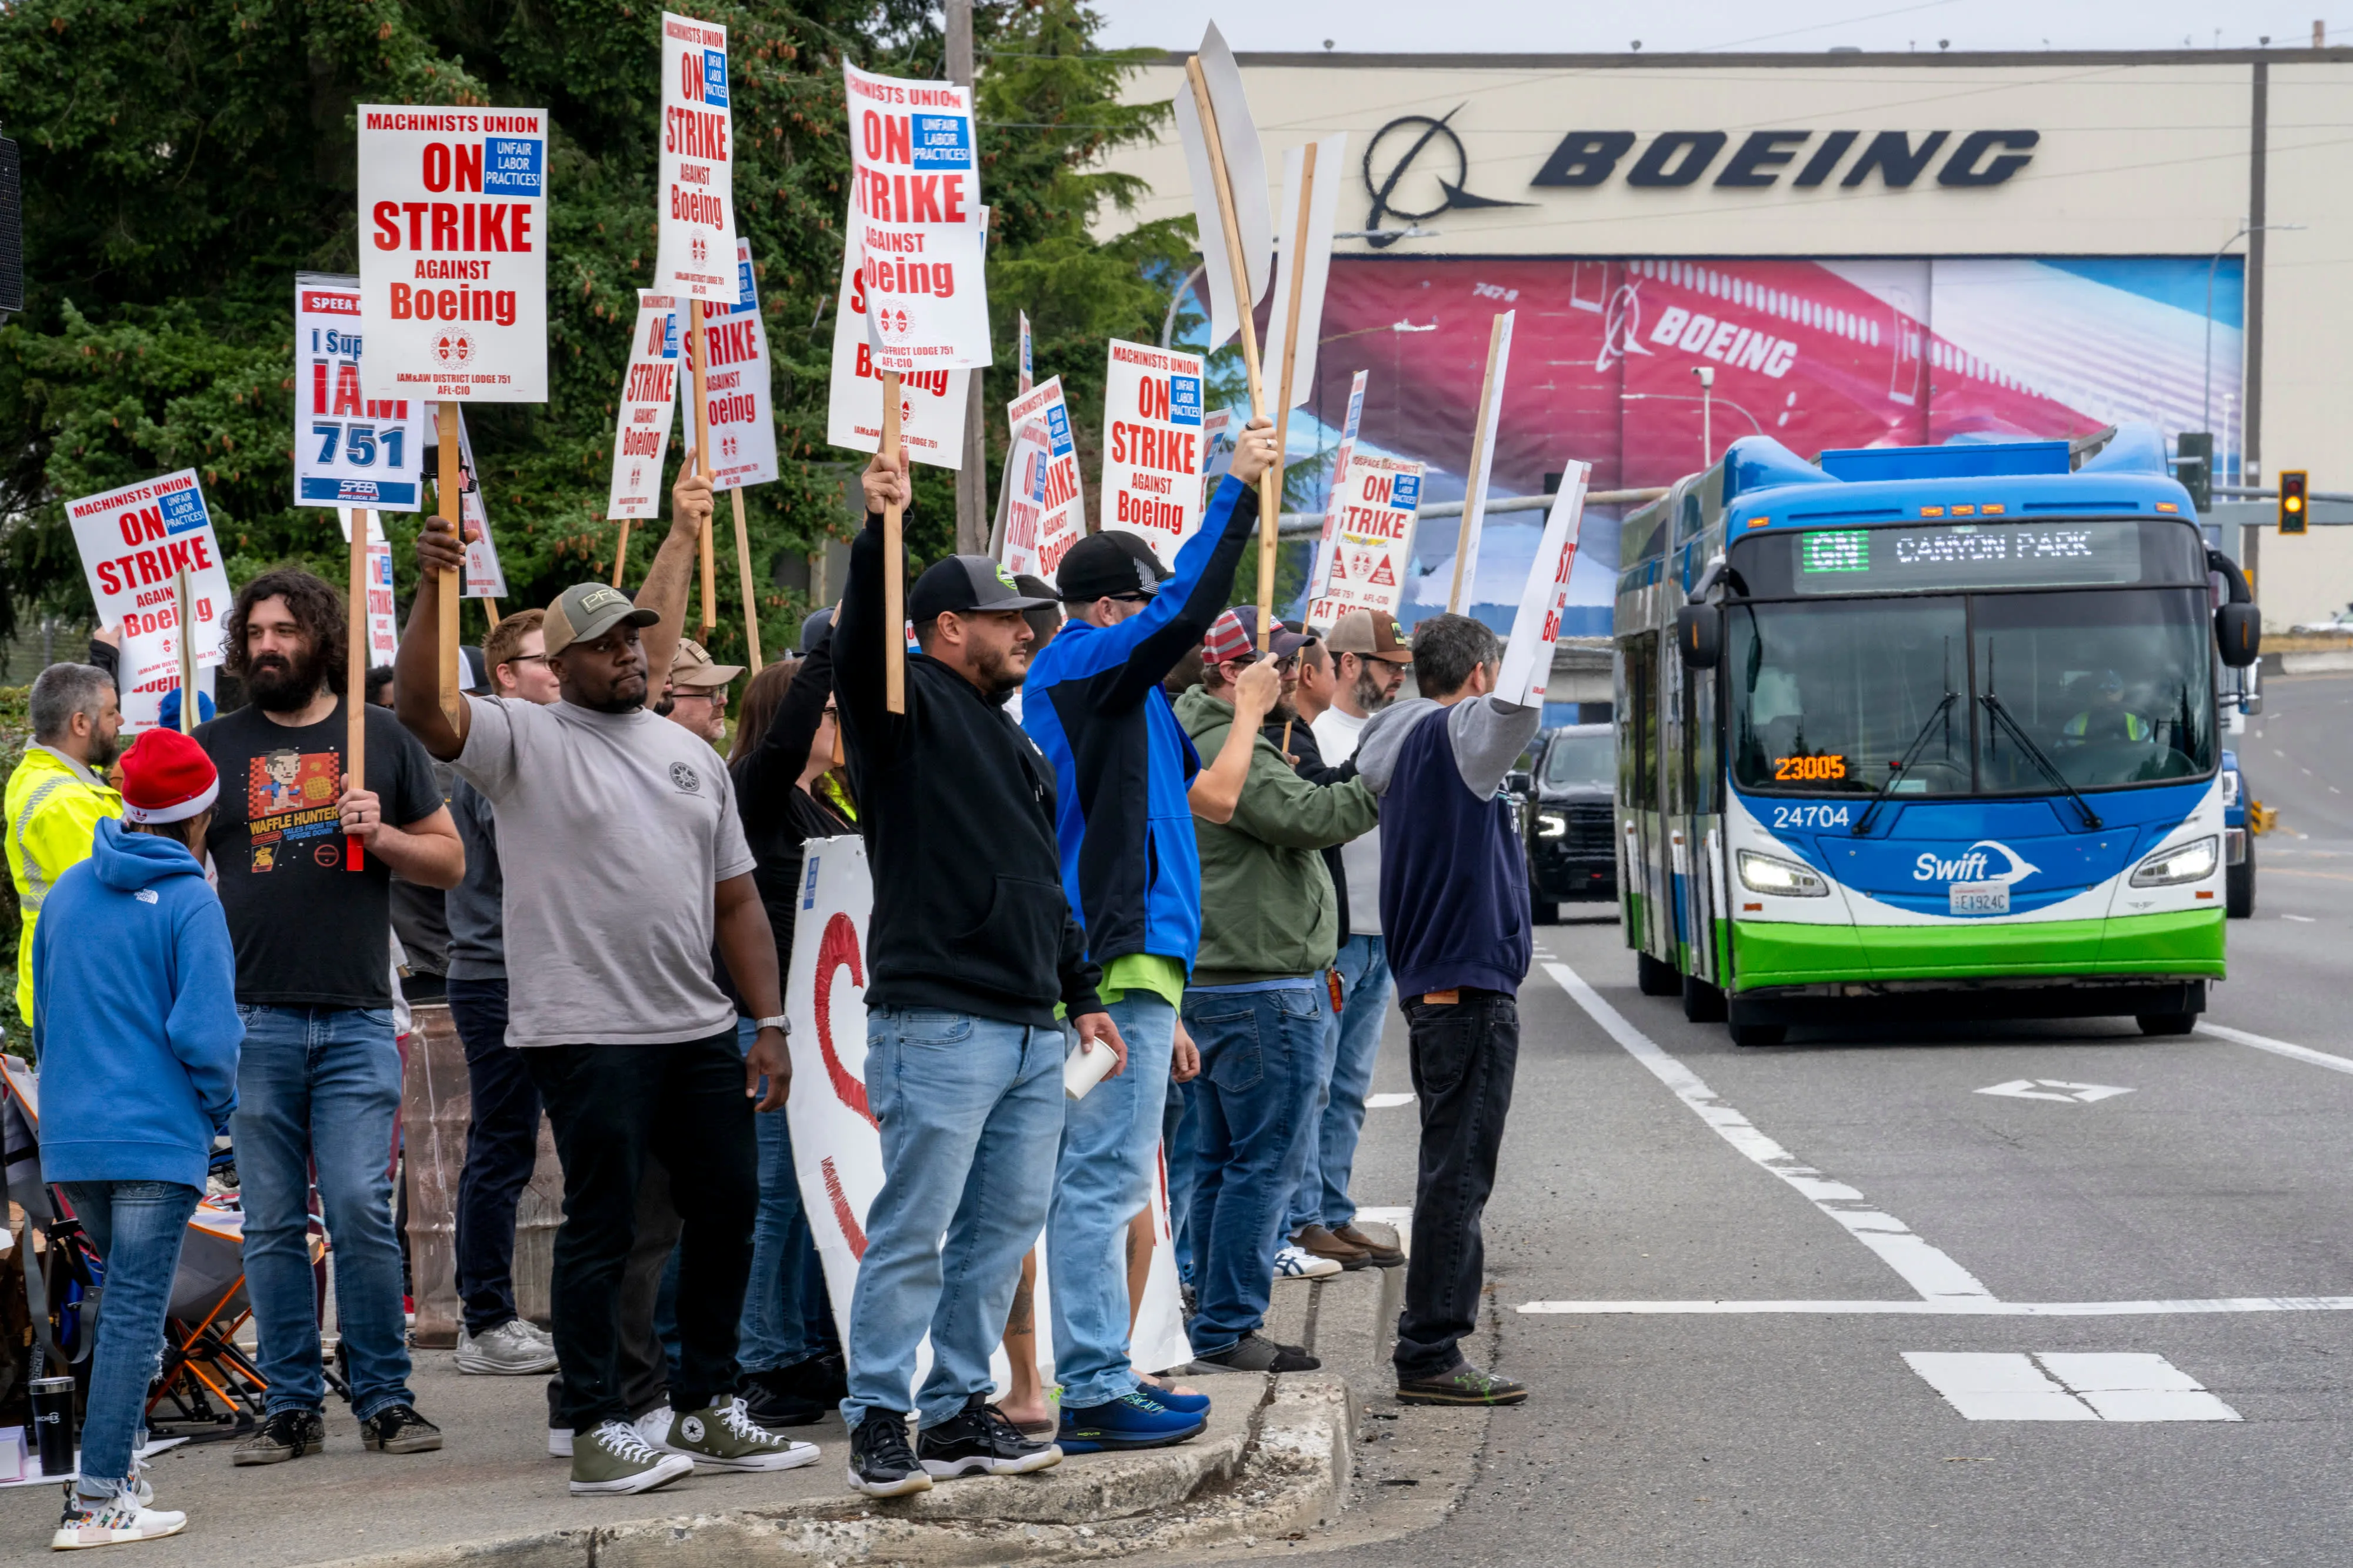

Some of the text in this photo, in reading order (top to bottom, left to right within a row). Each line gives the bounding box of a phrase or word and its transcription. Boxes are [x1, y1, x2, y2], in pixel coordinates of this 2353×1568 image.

[702, 29, 723, 48] UNION
[708, 54, 722, 68] UNFAIR
[682, 52, 704, 102] ON
[709, 68, 722, 82] LABOR
[366, 113, 538, 133] MACHINISTS UNION
[666, 105, 726, 161] STRIKE
[922, 119, 958, 131] UNFAIR
[864, 109, 911, 165] ON
[924, 134, 957, 146] LABOR
[496, 142, 531, 156] UNFAIR
[913, 147, 970, 161] PRACTICES!
[1528, 129, 2041, 189] BOEING
[423, 142, 482, 193] ON
[498, 156, 530, 170] LABOR
[680, 163, 710, 185] AGAINST
[486, 172, 540, 187] PRACTICES!
[671, 184, 723, 231] Boeing
[373, 201, 532, 253] STRIKE
[866, 226, 925, 252] AGAINST
[415, 259, 491, 280] AGAINST
[312, 297, 352, 311] SPEEA
[390, 282, 516, 326] Boeing
[648, 317, 666, 356] ON
[1649, 306, 1798, 378] BOEING
[912, 346, 938, 355] LODGE
[940, 346, 954, 355] 751
[1114, 346, 1199, 376] MACHINISTS UNION
[882, 358, 912, 368] AFL-CIO
[396, 373, 511, 384] IAM&AW DISTRICT LODGE 751
[437, 385, 470, 395] AFL-CIO
[627, 363, 674, 402] STRIKE
[706, 371, 741, 392] AGAINST
[1176, 379, 1195, 392] UNFAIR
[708, 392, 755, 426] oeing
[1139, 376, 1169, 422] ON
[1176, 392, 1194, 404] LABOR
[312, 421, 405, 469] 751
[623, 426, 660, 459] Boeing
[854, 425, 880, 438] IAM&AW
[909, 434, 927, 446] LODGE
[928, 440, 937, 449] 751
[1112, 421, 1195, 475] STRIKE
[339, 481, 380, 496] SPEEA
[1044, 456, 1078, 512] RIKE
[1132, 472, 1172, 495] AGAINST
[1363, 475, 1392, 503] ON
[73, 476, 193, 518] MACHINISTS UNION
[166, 492, 193, 507] UNFAIR
[165, 511, 204, 529] PRACTICES!
[171, 503, 194, 517] LABOR
[1117, 489, 1184, 535] Boeing
[119, 505, 167, 547] ON
[1008, 500, 1039, 551] STRIKE
[1897, 534, 2006, 563] CANYON
[2017, 531, 2092, 558] PARK
[96, 536, 212, 596] STRIKE
[136, 586, 174, 609] AGAIN
[1342, 590, 1354, 599] 751
[122, 597, 214, 638] Boeig
[1314, 600, 1334, 618] AT
[1774, 755, 1845, 780] 23005
[249, 806, 339, 835] WAFFLE HUNTER
[282, 826, 304, 835] TALES
[305, 822, 324, 830] FROM
[1773, 806, 1849, 828] 24704
[286, 828, 333, 840] UPSIDE DOWN
[1913, 852, 1988, 881] Swift
